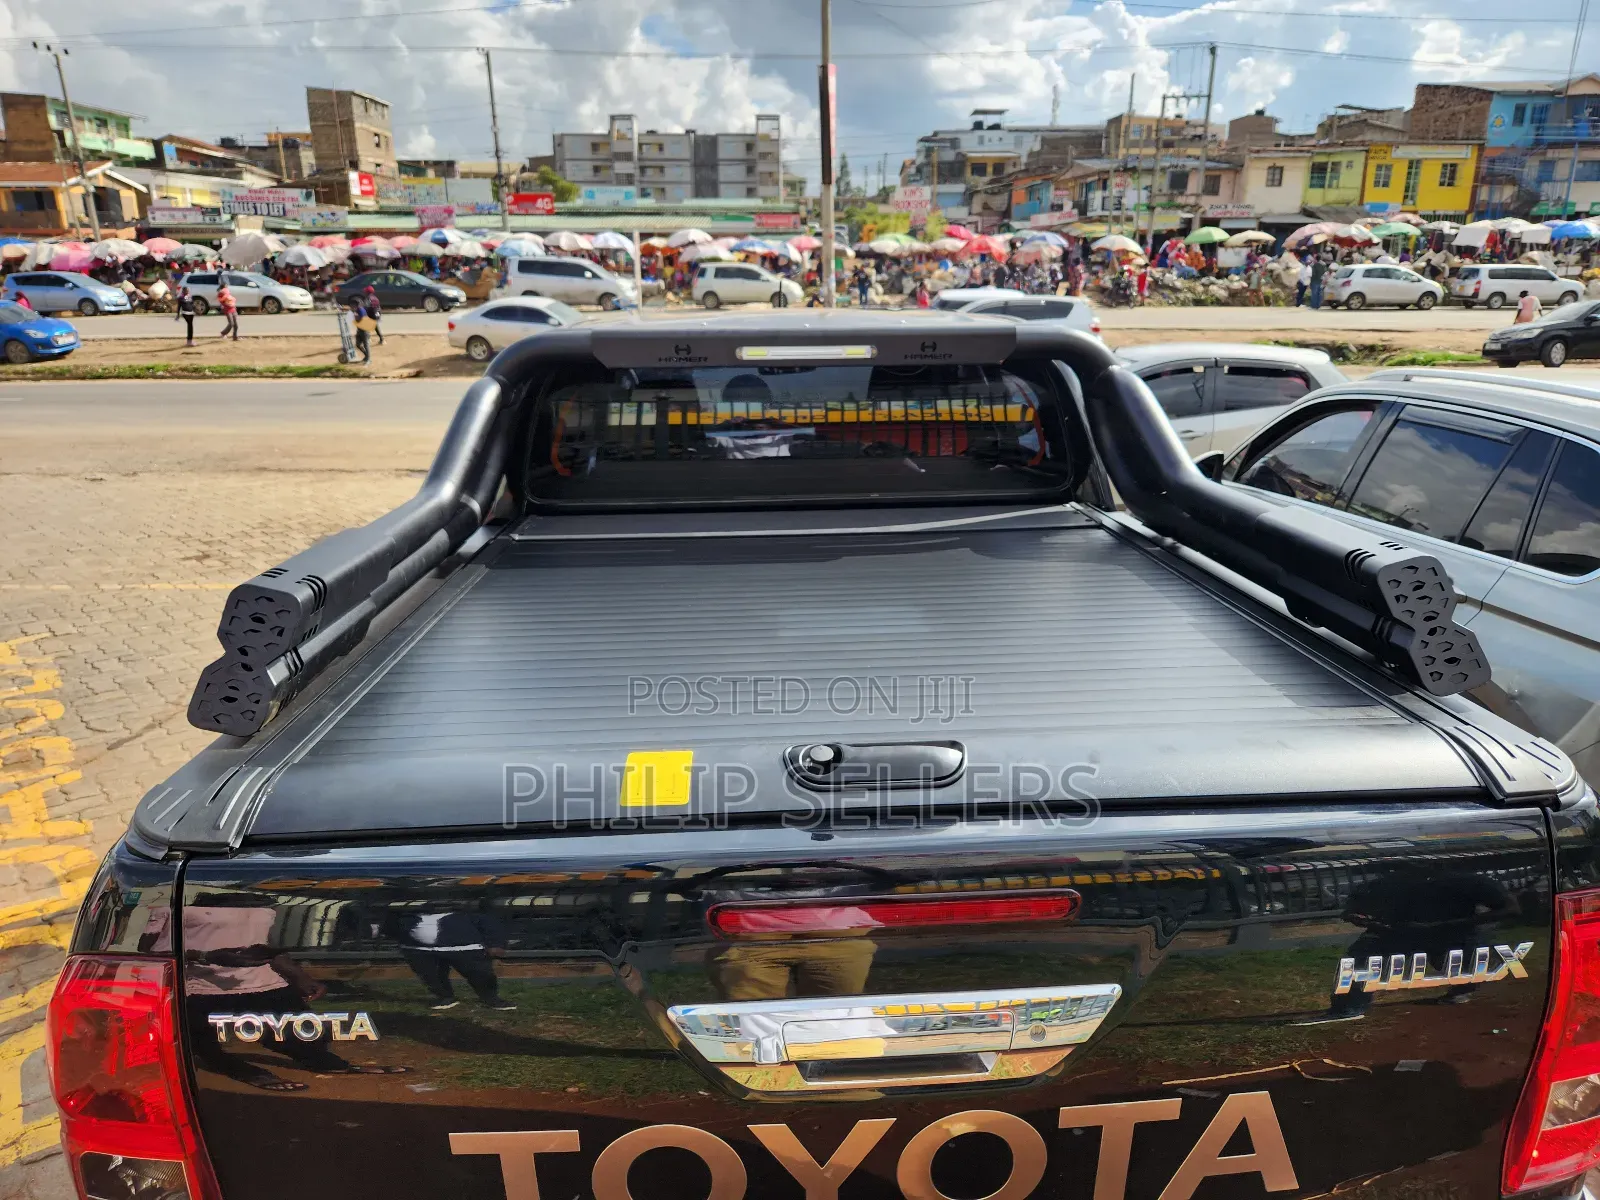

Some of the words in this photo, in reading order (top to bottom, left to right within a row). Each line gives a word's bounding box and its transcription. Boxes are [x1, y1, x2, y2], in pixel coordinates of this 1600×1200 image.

[223, 202, 256, 215] STALLS
[257, 203, 269, 216] TO
[270, 203, 284, 216] LET
[536, 198, 552, 209] 4G
[1335, 941, 1534, 995] HILUX
[207, 1012, 380, 1043] TOYOTA
[448, 1090, 1300, 1200] TOYOTA
